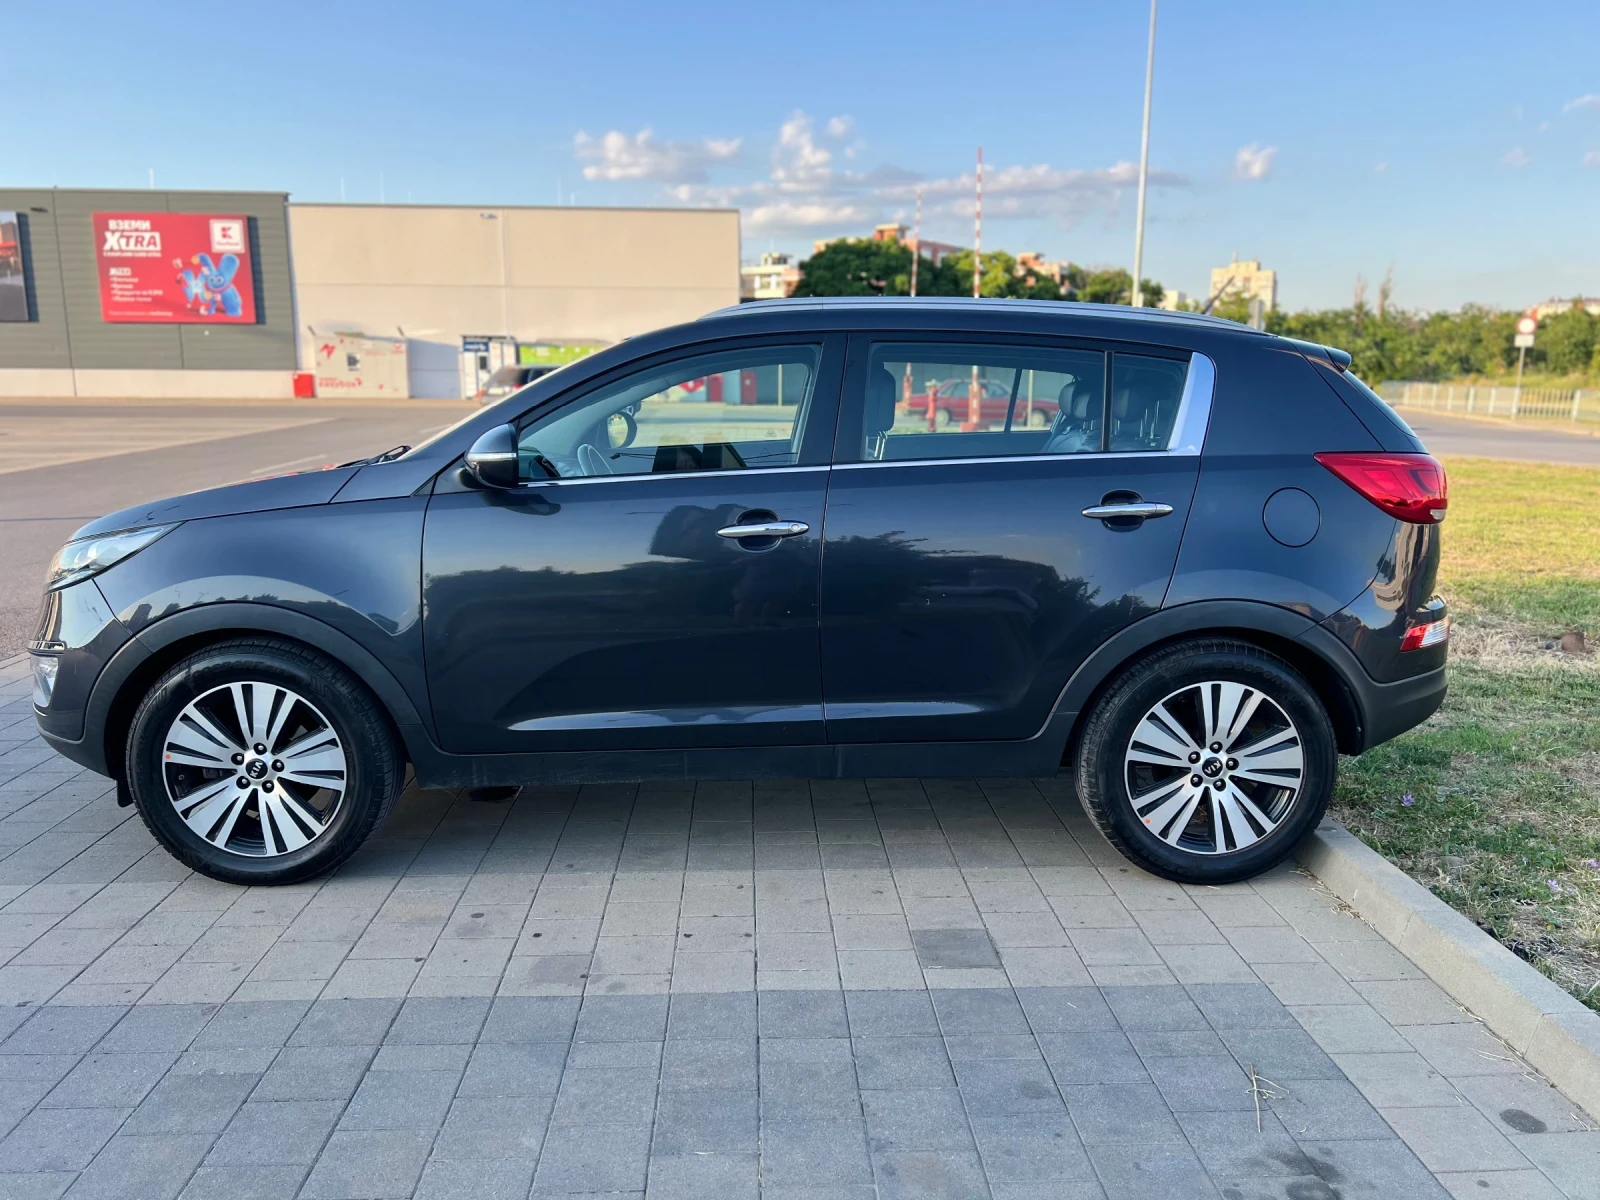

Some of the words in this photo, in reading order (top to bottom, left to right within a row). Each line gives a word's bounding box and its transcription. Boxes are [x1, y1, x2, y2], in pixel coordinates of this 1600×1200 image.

[108, 219, 151, 231] ВЗЕМИ
[103, 231, 161, 251] XTRA
[249, 761, 264, 778] KIA
[1204, 760, 1222, 774] KIA
